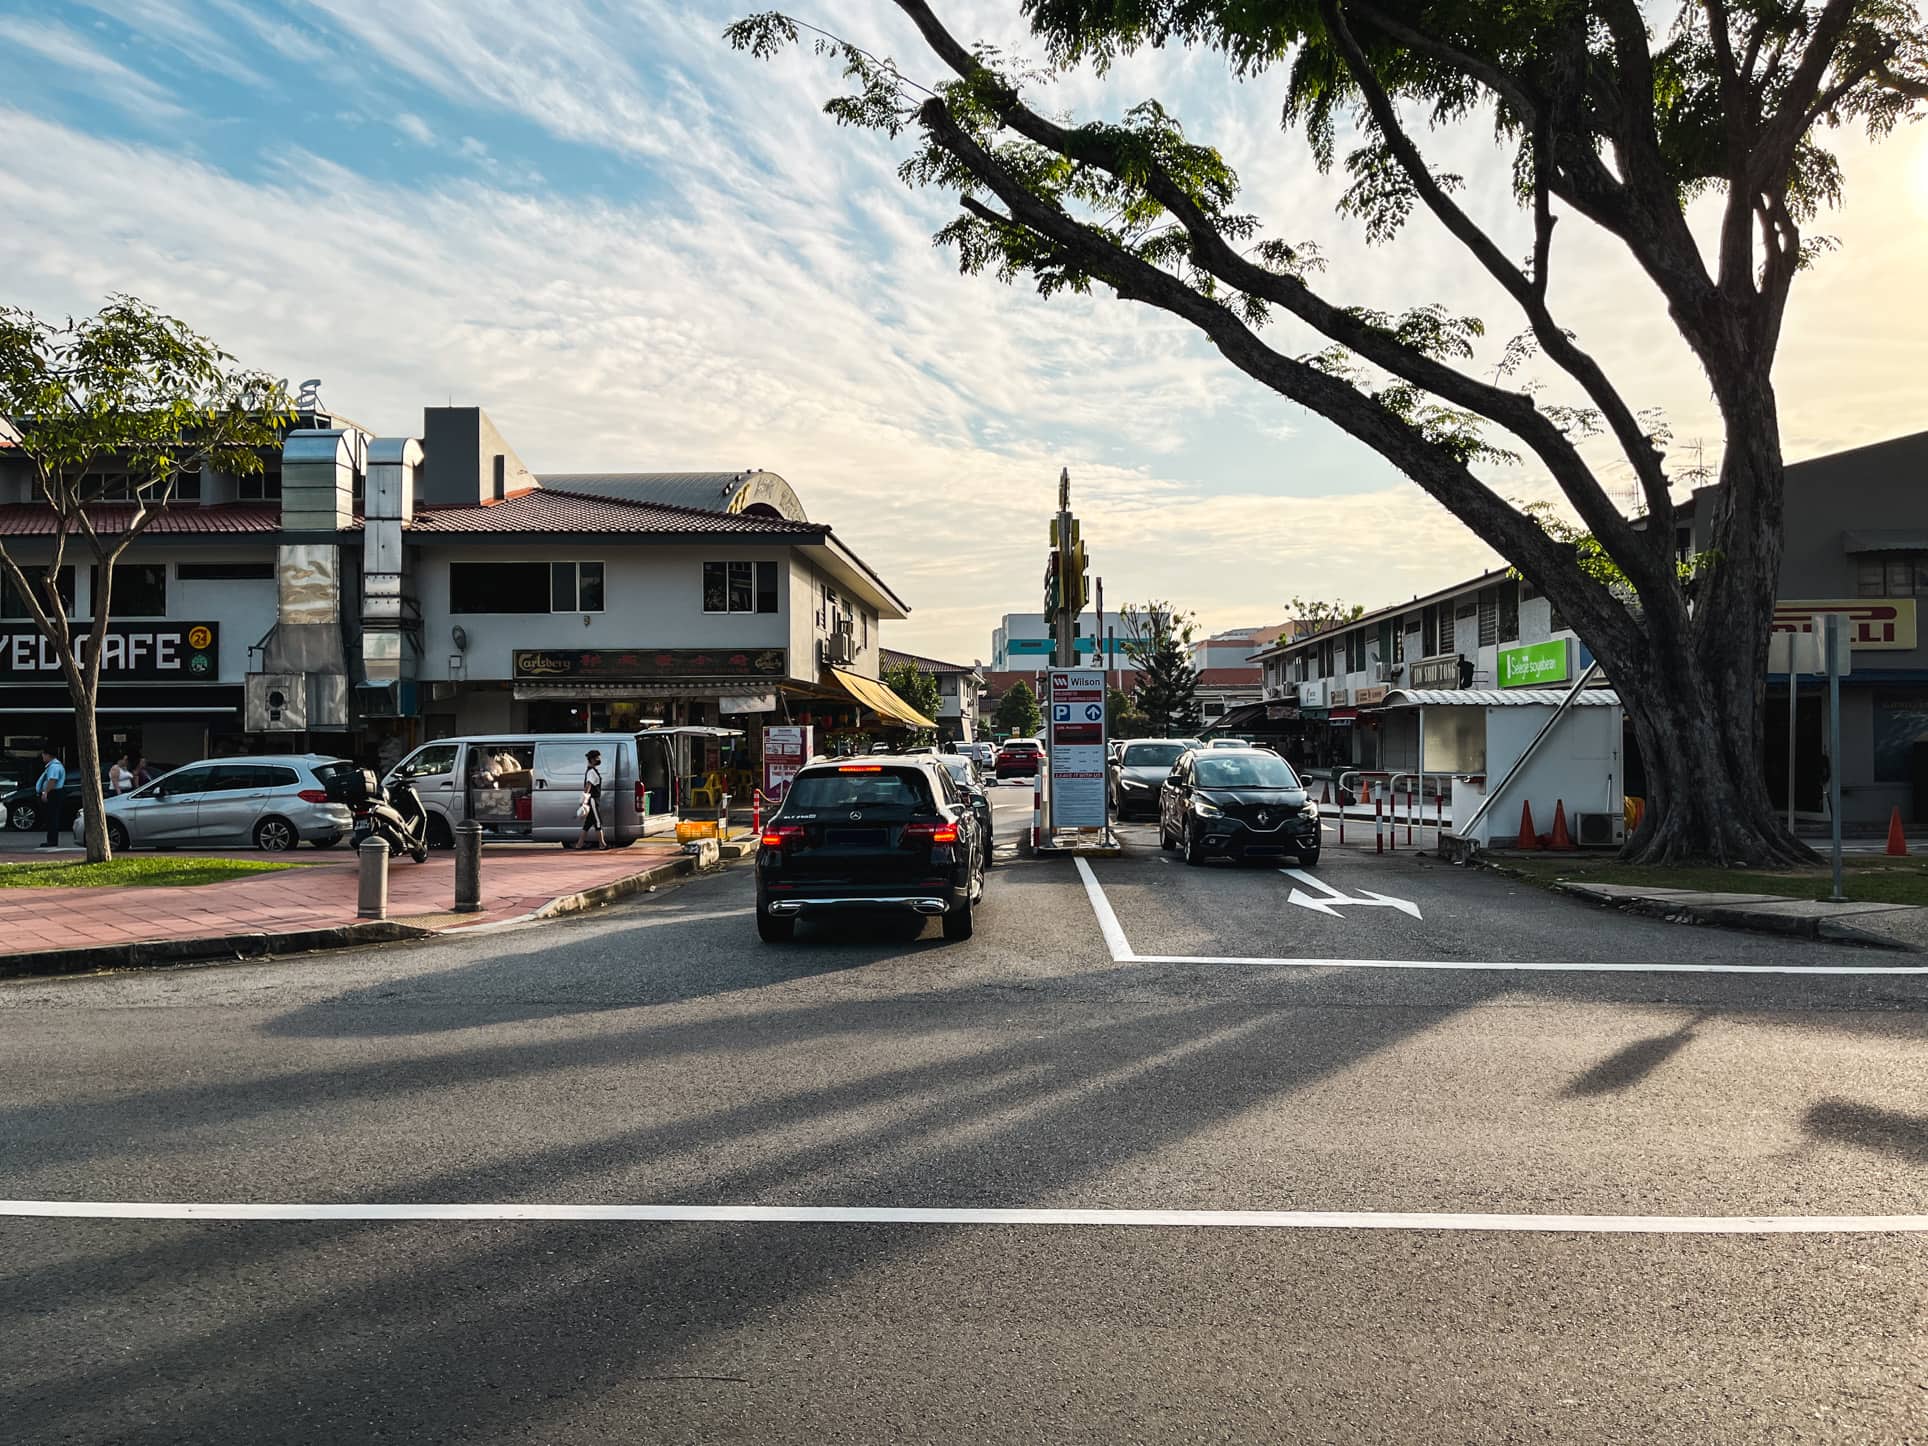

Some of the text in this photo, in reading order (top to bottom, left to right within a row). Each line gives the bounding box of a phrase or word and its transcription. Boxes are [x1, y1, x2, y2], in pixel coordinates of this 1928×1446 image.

[74, 634, 181, 669] CAFE
[518, 653, 571, 671] Carlsberg
[1071, 677, 1101, 686] Wilson
[1056, 706, 1068, 720] P
